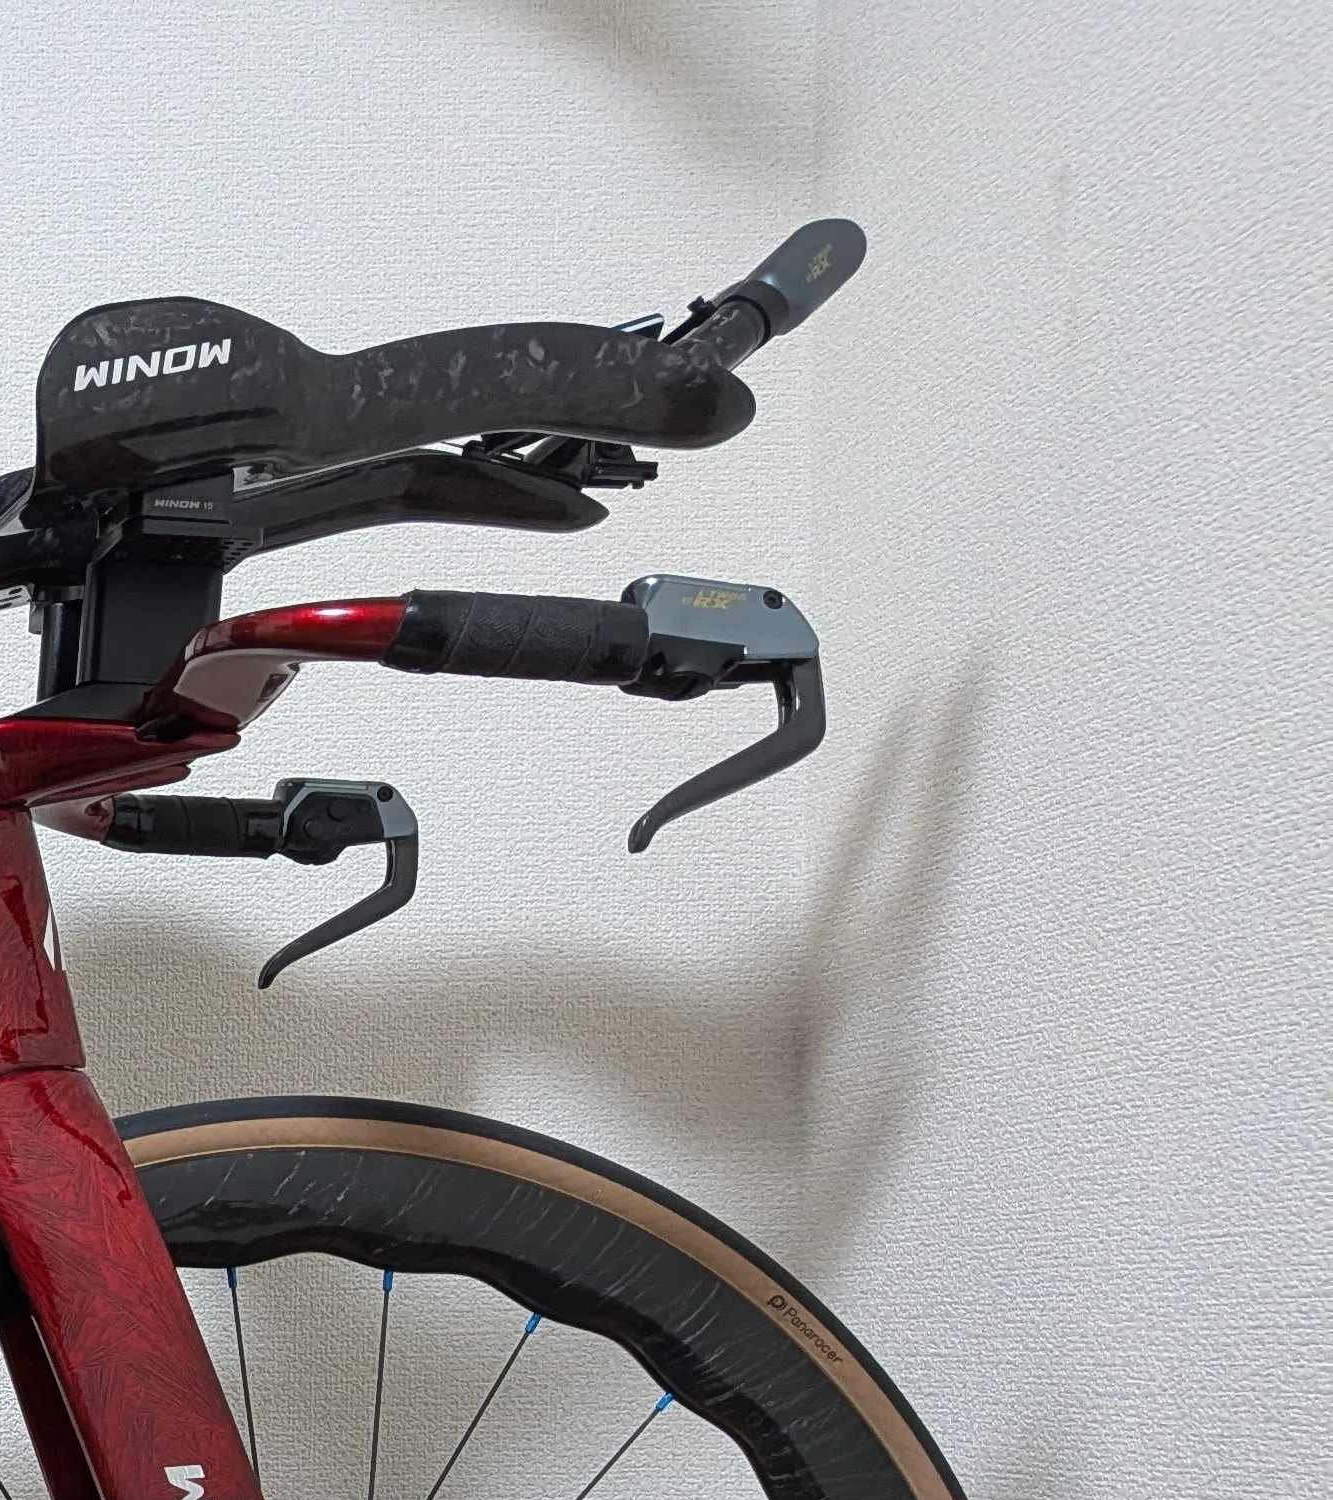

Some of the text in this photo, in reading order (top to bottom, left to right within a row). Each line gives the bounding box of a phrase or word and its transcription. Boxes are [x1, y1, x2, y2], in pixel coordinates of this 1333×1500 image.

[74, 338, 231, 391] WINOW
[154, 499, 200, 509] WINOW
[783, 1305, 844, 1364] Panaracer
